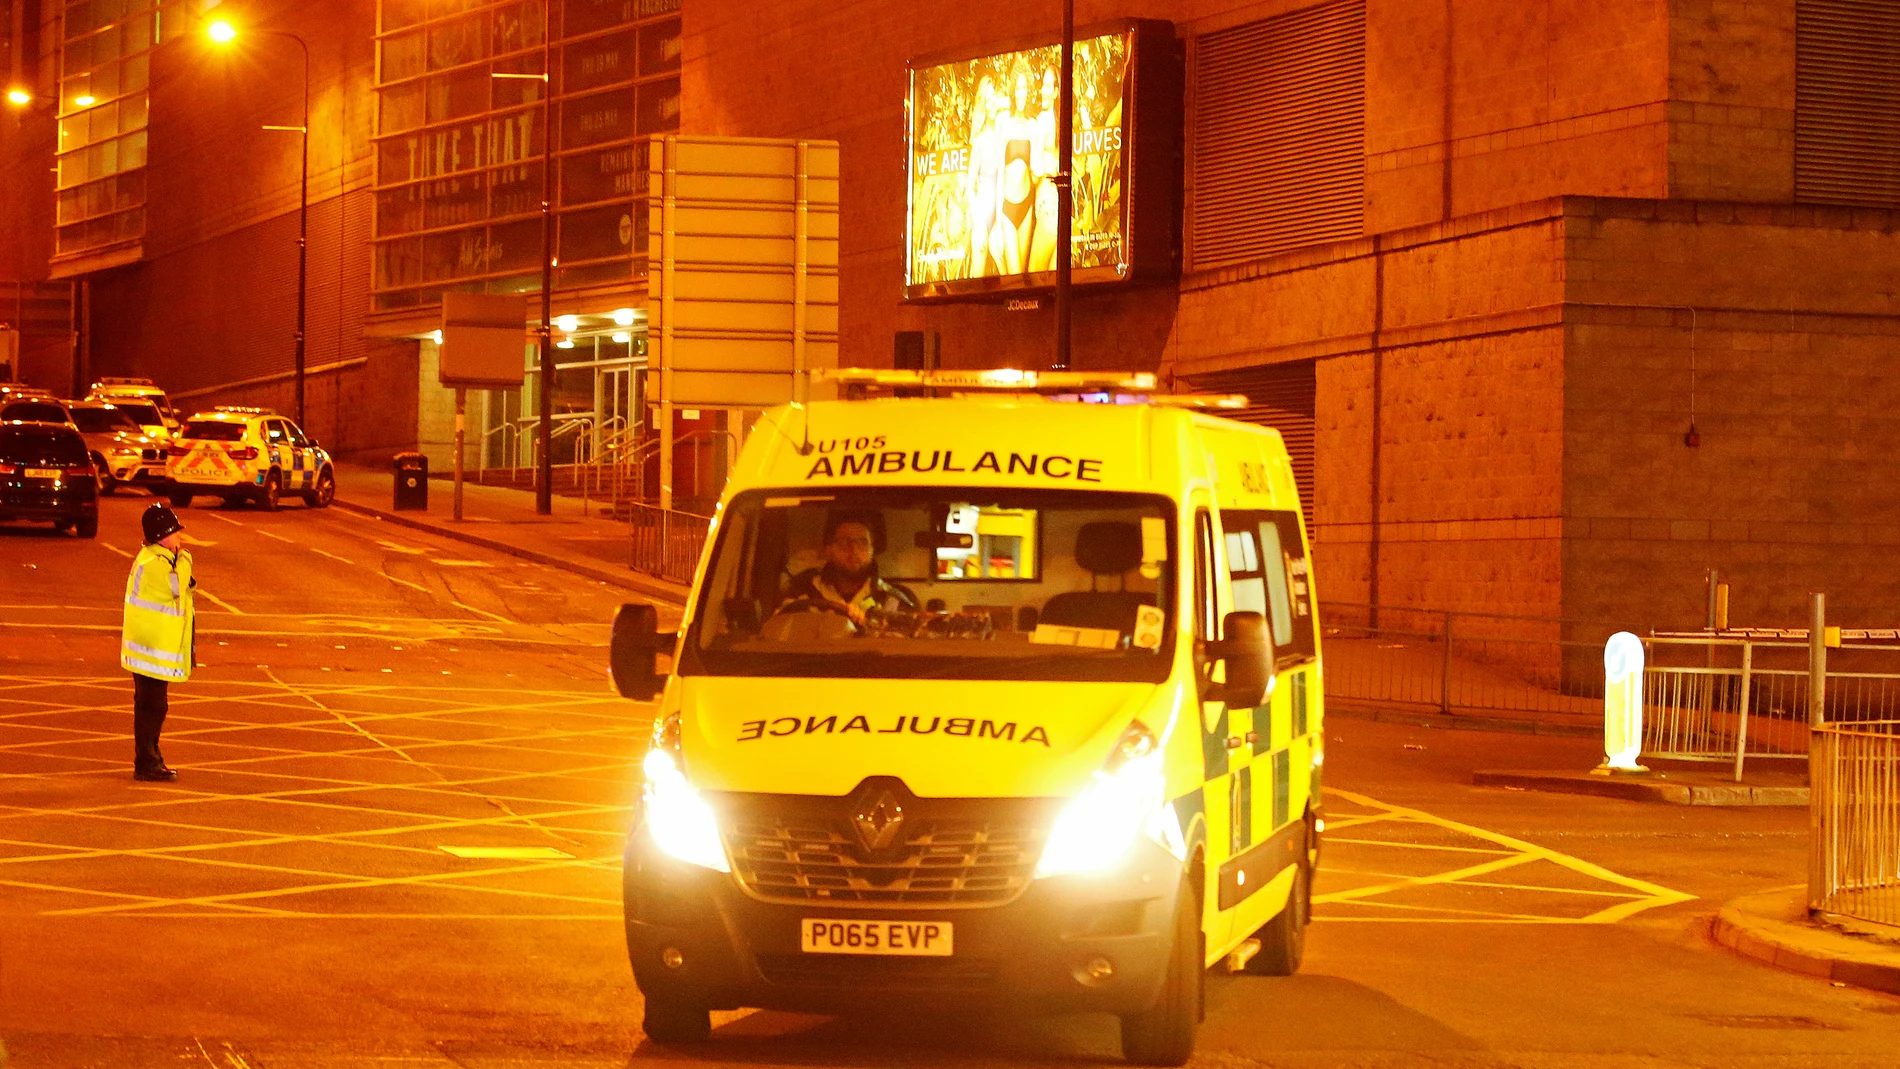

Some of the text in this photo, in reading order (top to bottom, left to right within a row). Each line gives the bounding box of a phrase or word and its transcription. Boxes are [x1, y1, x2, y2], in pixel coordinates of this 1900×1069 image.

[407, 115, 532, 201] TAKE THAT
[916, 126, 1122, 176] WE ARE URVES
[1007, 299, 1039, 311] JCDecaux
[818, 435, 887, 454] U105
[181, 468, 229, 476] POLICE
[806, 450, 1103, 483] AMBULANCE
[812, 923, 939, 949] PO65 EVP
